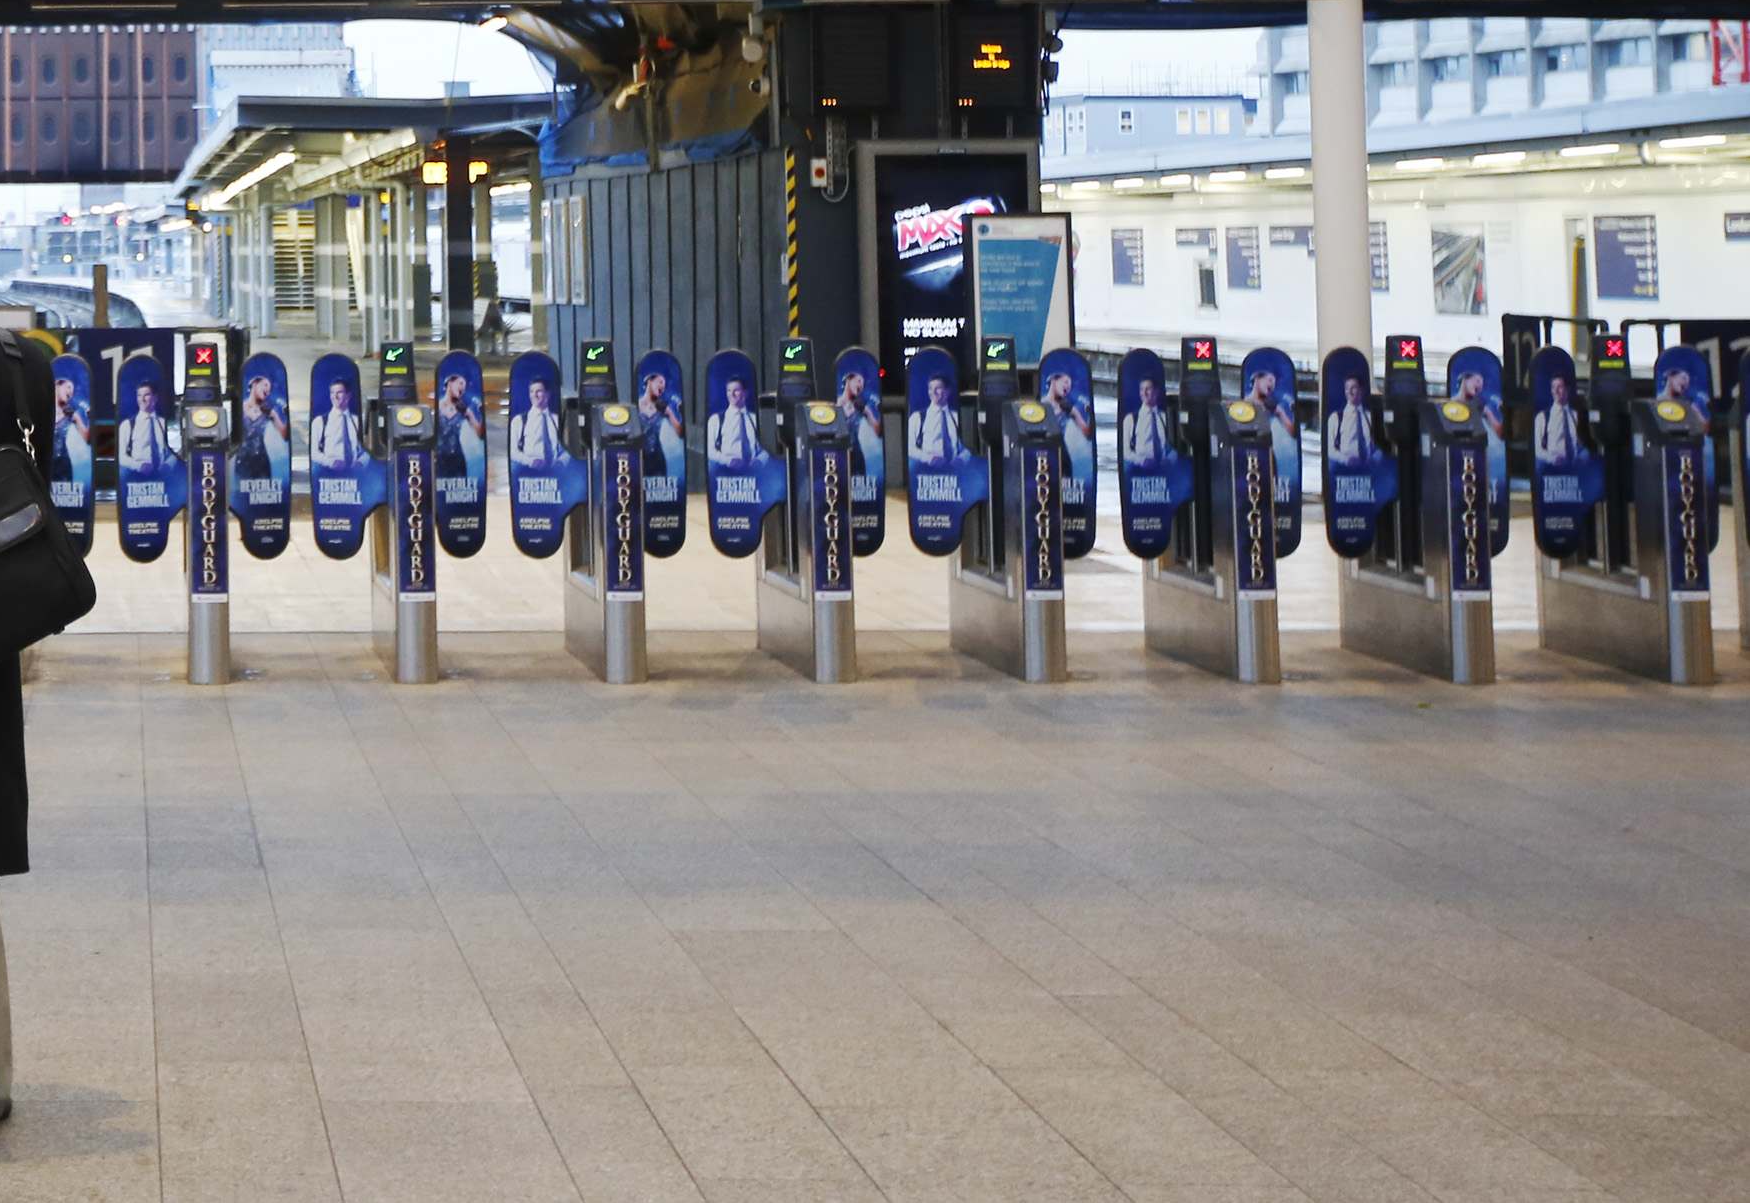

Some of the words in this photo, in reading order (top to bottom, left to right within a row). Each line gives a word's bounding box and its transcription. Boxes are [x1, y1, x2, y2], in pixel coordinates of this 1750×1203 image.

[241, 480, 281, 492] BEVERLEY
[320, 480, 356, 492] TRISTAN
[437, 478, 476, 490] BEVERLEY
[520, 479, 557, 491] TRISTAN
[716, 477, 756, 490] TRISTAN
[918, 476, 956, 488] TRISTAN
[1132, 478, 1166, 489] TRISTAN
[127, 483, 165, 495] TRISTAN
[918, 487, 960, 500] GEMMILL
[1132, 488, 1169, 502] GEMMILL
[127, 495, 169, 508] GEMMILL
[249, 491, 282, 504] KNIGHT
[320, 492, 360, 503] GEMMILL
[445, 490, 478, 503] KNIGHT
[519, 490, 560, 502] GEMMILL
[716, 489, 761, 503] GEMMILL
[201, 460, 217, 586] BODYGUARD
[407, 459, 424, 584] BODYGUARD
[616, 459, 632, 585] BODYGUARD
[823, 458, 840, 581] BODYGUARD
[1035, 456, 1052, 580] BODYGUARD
[1245, 456, 1264, 580] BODYGUARD
[1461, 456, 1479, 581] BODYGUARD
[1678, 455, 1698, 581] BODYGUARD
